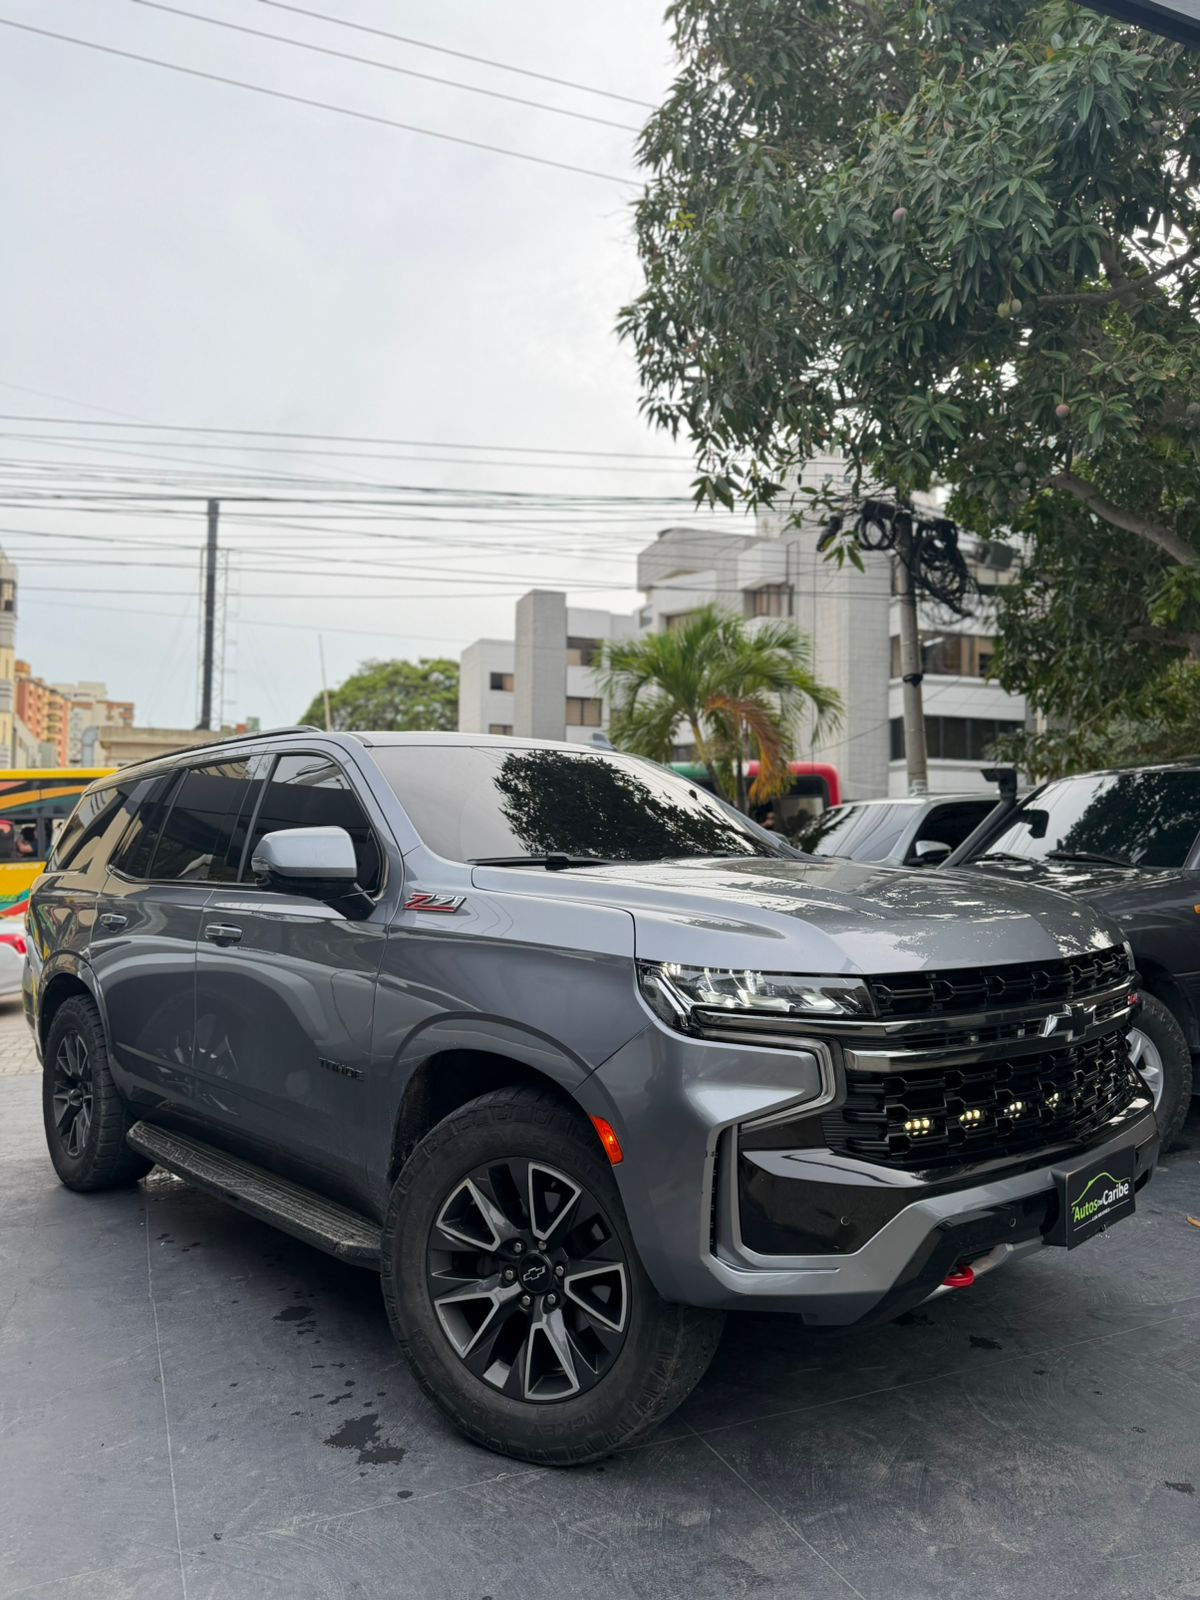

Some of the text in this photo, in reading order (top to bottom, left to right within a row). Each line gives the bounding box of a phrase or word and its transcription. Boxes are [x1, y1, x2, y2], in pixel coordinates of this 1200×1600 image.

[403, 892, 467, 913] Z71
[1073, 1200, 1098, 1223] Autos
[1102, 1183, 1129, 1205] Caribe
